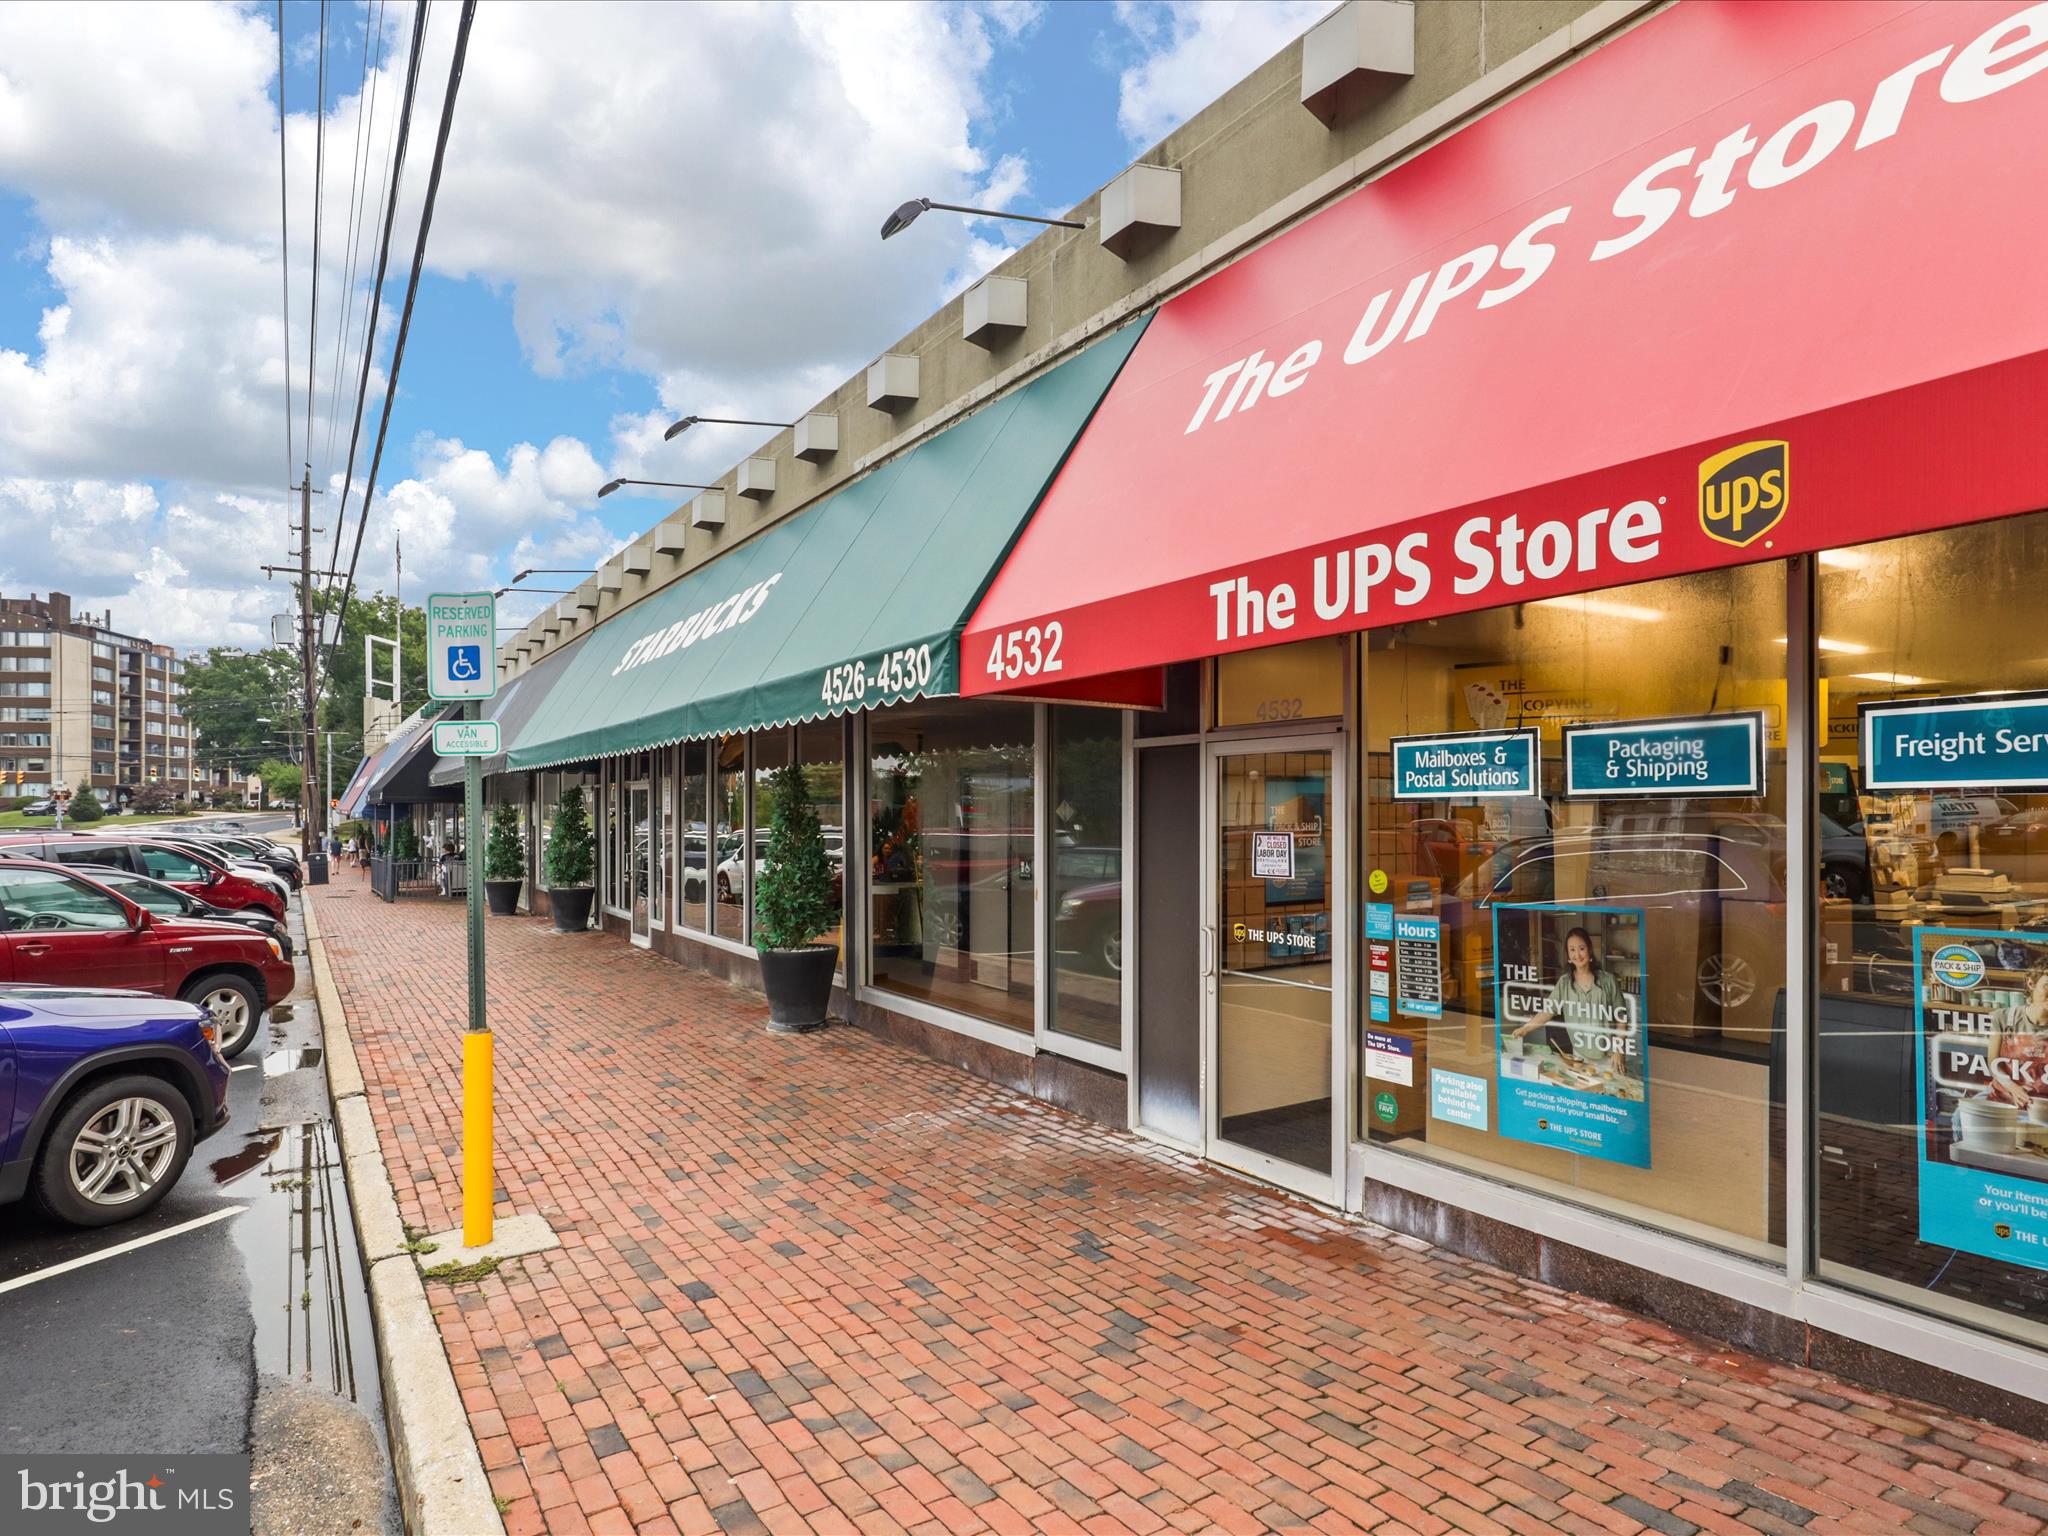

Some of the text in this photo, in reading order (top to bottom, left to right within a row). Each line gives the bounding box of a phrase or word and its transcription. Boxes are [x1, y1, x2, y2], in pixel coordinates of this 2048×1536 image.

[1185, 0, 2048, 435] The UPS Store
[1706, 469, 1783, 532] ups
[1210, 499, 1663, 641] The UPS Store
[432, 605, 491, 621] RESERVED
[437, 624, 488, 638] PARKING
[612, 572, 783, 676] STARBUCKS
[985, 620, 1064, 682] 4532
[821, 643, 932, 706] 4526-4530
[1499, 680, 1526, 691] THE
[1256, 698, 1304, 721] 4532
[446, 740, 489, 748] ACCESSIBLE
[457, 728, 478, 739] VAN
[1414, 746, 1508, 768] Mailboxes &
[1608, 737, 1705, 760] Packaging
[1895, 731, 1987, 762] Freight
[1405, 765, 1520, 788] Postal Solutions
[1605, 757, 1709, 781] & Shipping
[1266, 841, 1287, 849] CLOSED
[1298, 837, 1322, 848] STORE
[1256, 849, 1288, 858] LABOR DAY
[1248, 928, 1316, 949] THE UPS STORE
[1398, 922, 1438, 938] Hours
[1503, 963, 1538, 982] THE
[1934, 961, 1982, 972] PACK & SHIP
[1511, 994, 1628, 1024] EVERYTHING
[1932, 1009, 1994, 1035] THE
[1367, 1039, 1376, 1047] The
[1376, 1041, 1386, 1049] UPS
[1573, 1031, 1637, 1056] STORE
[1951, 1051, 2035, 1084] PACK
[1435, 1073, 1484, 1092] Parking also
[1438, 1094, 1481, 1112] behind the
[1441, 1086, 1478, 1101] available
[1515, 1087, 1527, 1097] Get
[1556, 1096, 1589, 1110] shipping,
[1589, 1103, 1628, 1117] mailboxes
[1378, 1103, 1395, 1114] FAVE
[1446, 1107, 1472, 1120] center
[1523, 1099, 1619, 1124] and more for your small biz.
[1549, 1122, 1563, 1133] THE
[1564, 1125, 1578, 1136] UPS
[1579, 1129, 1603, 1141] STORE
[1984, 1184, 2048, 1206] Your items
[1979, 1197, 2048, 1219] or you'll be
[2014, 1229, 2038, 1244] THE
